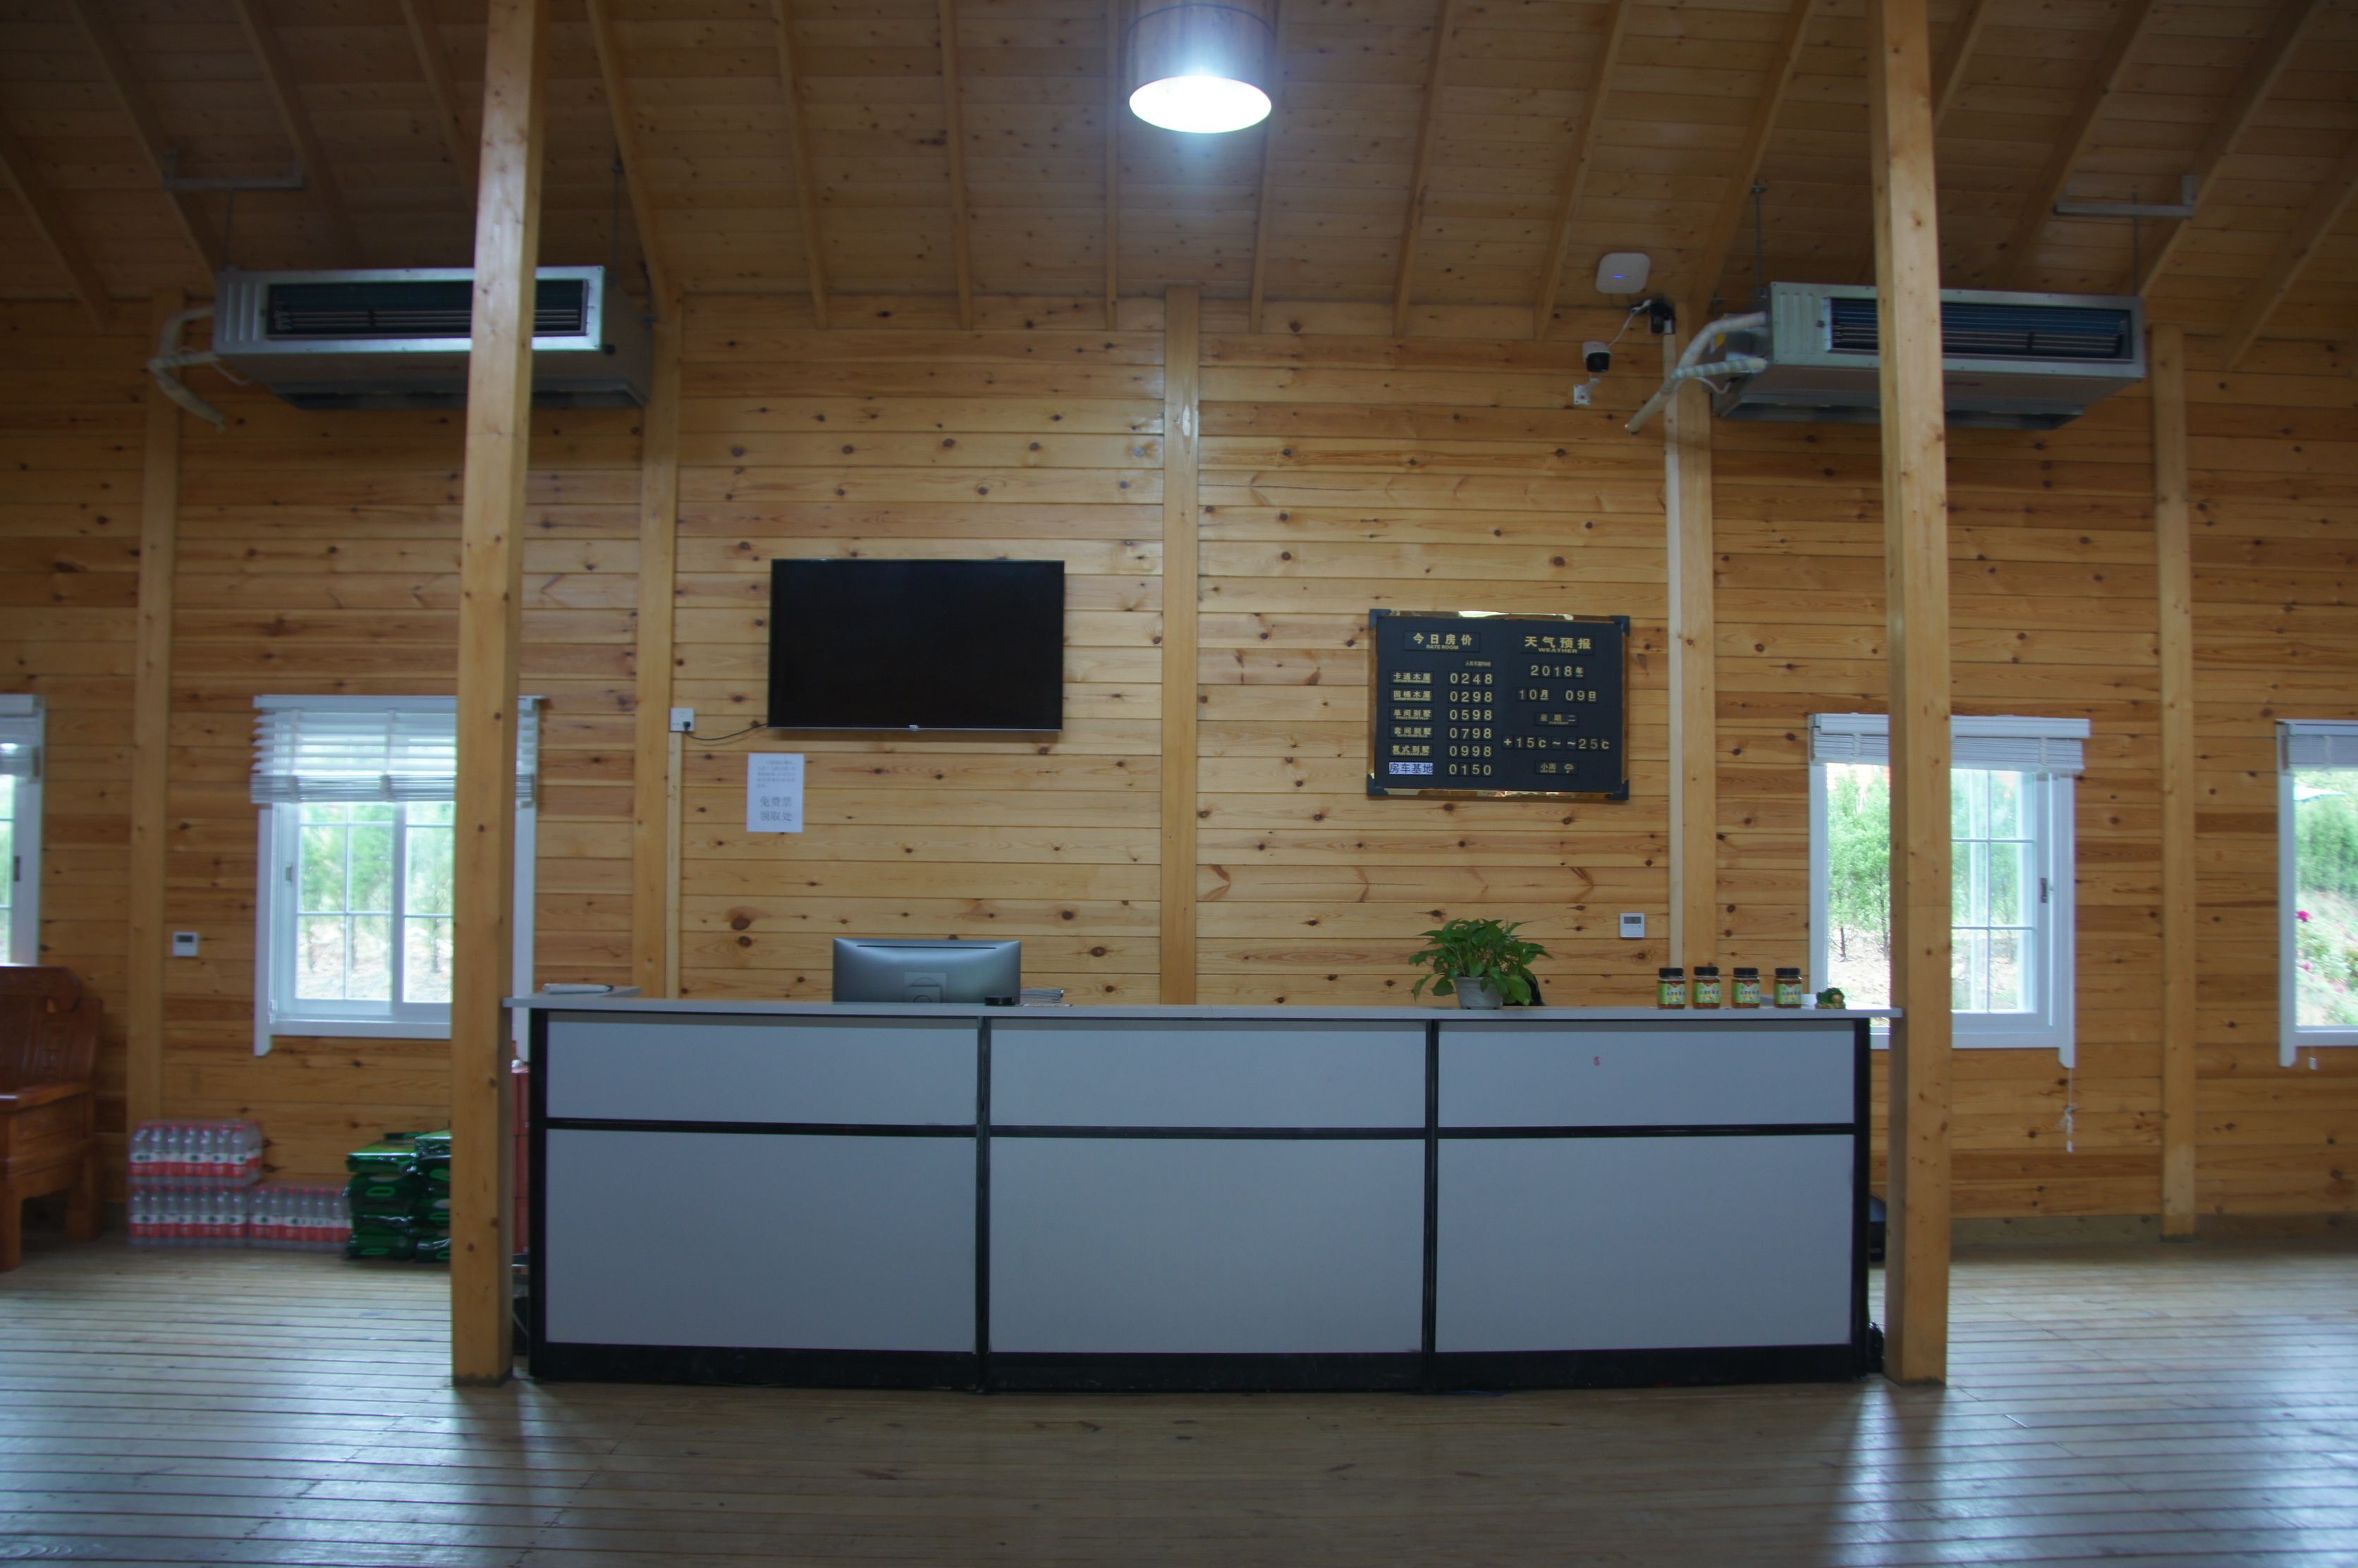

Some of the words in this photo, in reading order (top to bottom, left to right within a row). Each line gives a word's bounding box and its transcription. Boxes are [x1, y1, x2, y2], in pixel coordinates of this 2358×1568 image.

[1413, 632, 1472, 646] 今日房价
[1525, 636, 1592, 649] 天气预报
[1450, 673, 1493, 685] 0248
[1450, 691, 1493, 702] 0298
[1449, 709, 1492, 721] 0598
[1449, 728, 1492, 739] 0798
[1449, 746, 1491, 757] 0998
[1389, 763, 1433, 774] 房车基地
[1449, 764, 1492, 776] 0150
